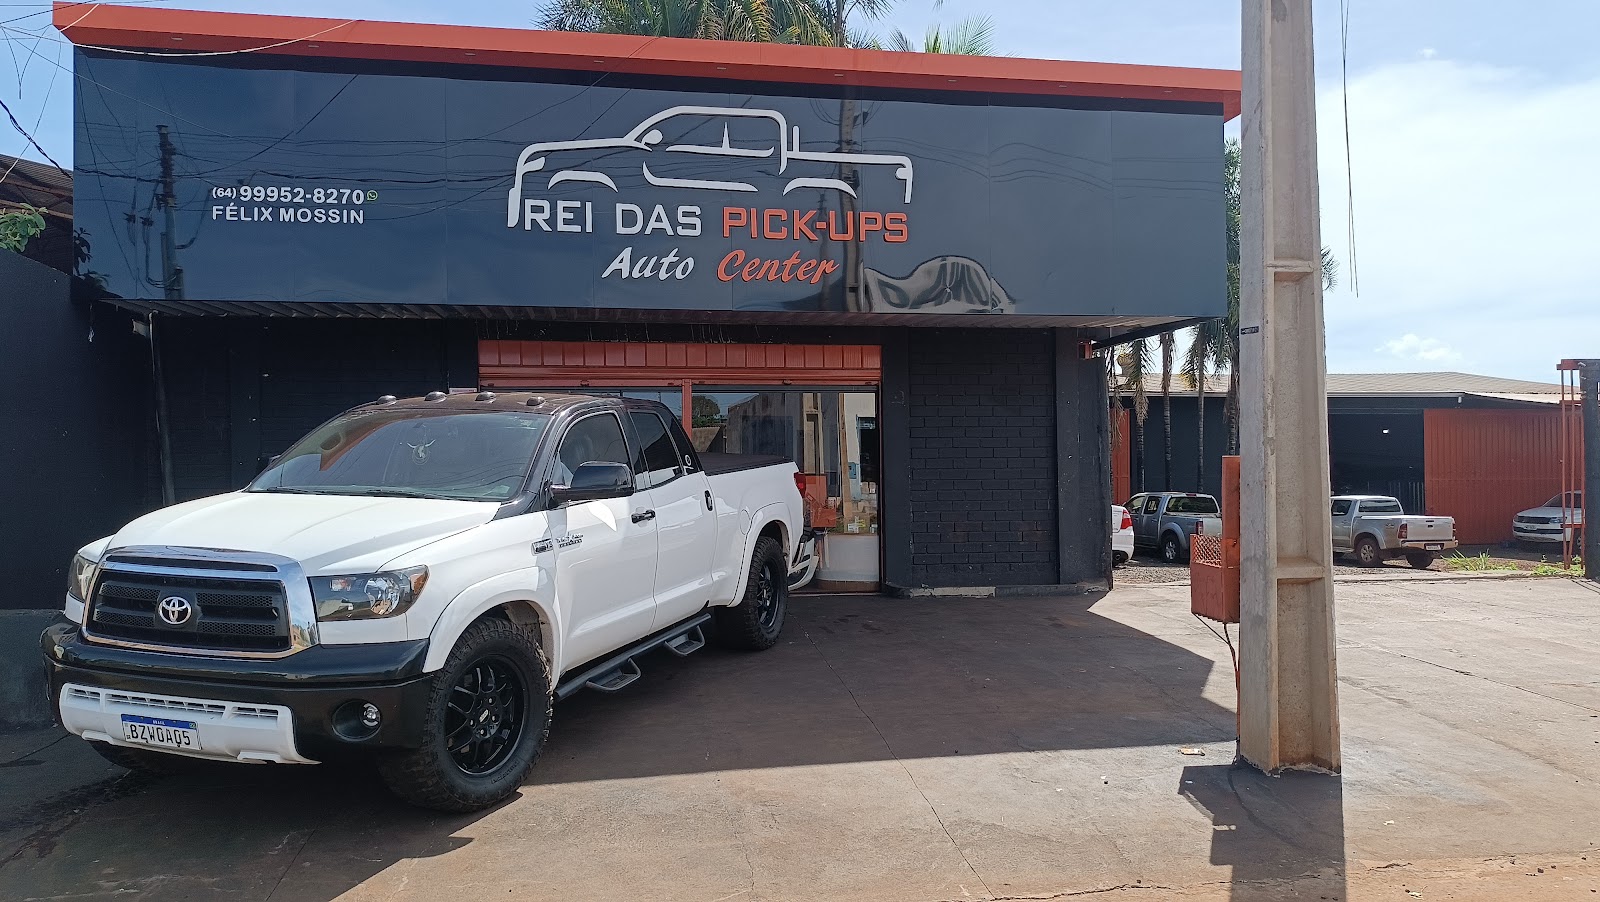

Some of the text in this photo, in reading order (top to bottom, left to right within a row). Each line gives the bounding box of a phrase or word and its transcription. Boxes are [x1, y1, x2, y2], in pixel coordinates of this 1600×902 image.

[212, 185, 365, 205] (64) 99952-8270
[212, 202, 364, 225] FÉLIX MOSSIN
[523, 199, 909, 242] REI DAS PICK-UPS
[601, 246, 840, 285] Auto Center
